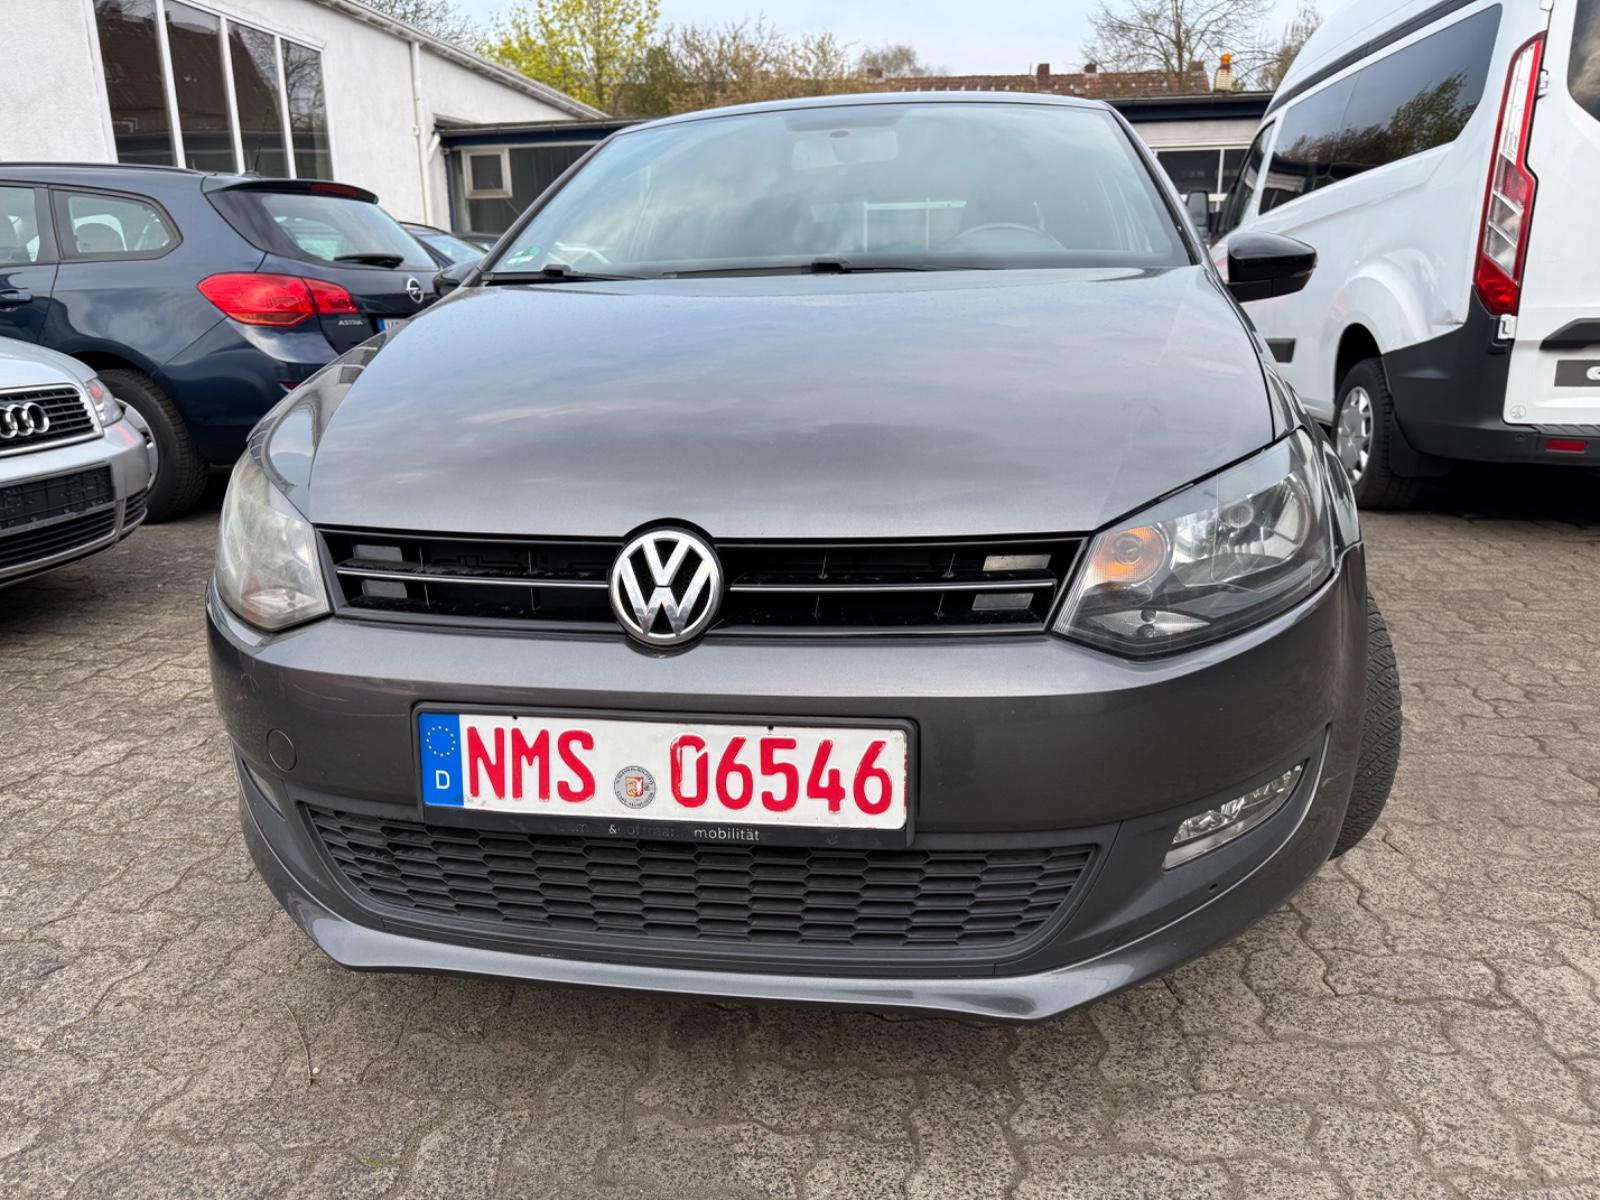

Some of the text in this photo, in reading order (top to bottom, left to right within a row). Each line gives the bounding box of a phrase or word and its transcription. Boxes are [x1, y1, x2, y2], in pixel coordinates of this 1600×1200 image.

[611, 530, 719, 643] VW
[435, 770, 450, 790] D
[467, 726, 596, 802] NMS
[670, 734, 893, 815] 06546
[608, 824, 617, 834] &
[694, 827, 760, 842] mobilität
